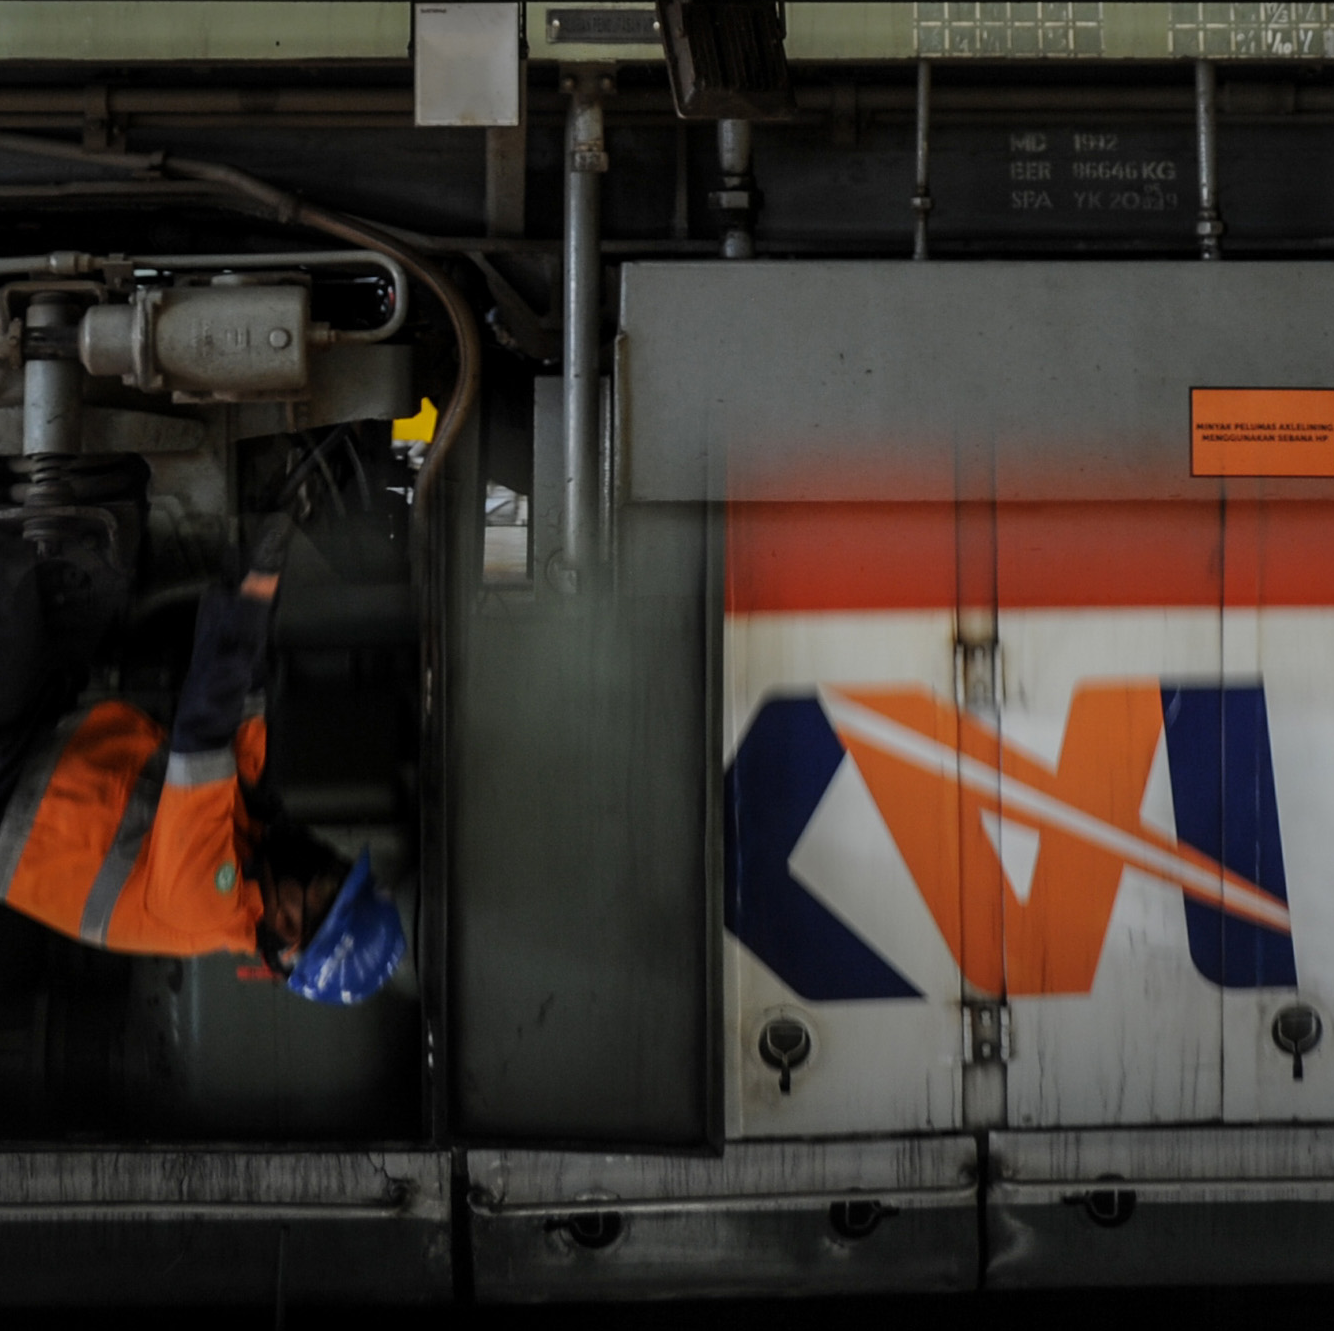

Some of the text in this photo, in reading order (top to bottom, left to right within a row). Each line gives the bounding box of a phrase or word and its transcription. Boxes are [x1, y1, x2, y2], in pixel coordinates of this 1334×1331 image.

[1141, 160, 1177, 181] KG
[1072, 190, 1102, 210] YK
[1196, 423, 1232, 431] MINYAK
[1234, 423, 1276, 431] PELUMAS
[1202, 434, 1275, 442] MENGGUNAKAN
[1315, 434, 1329, 442] HP
